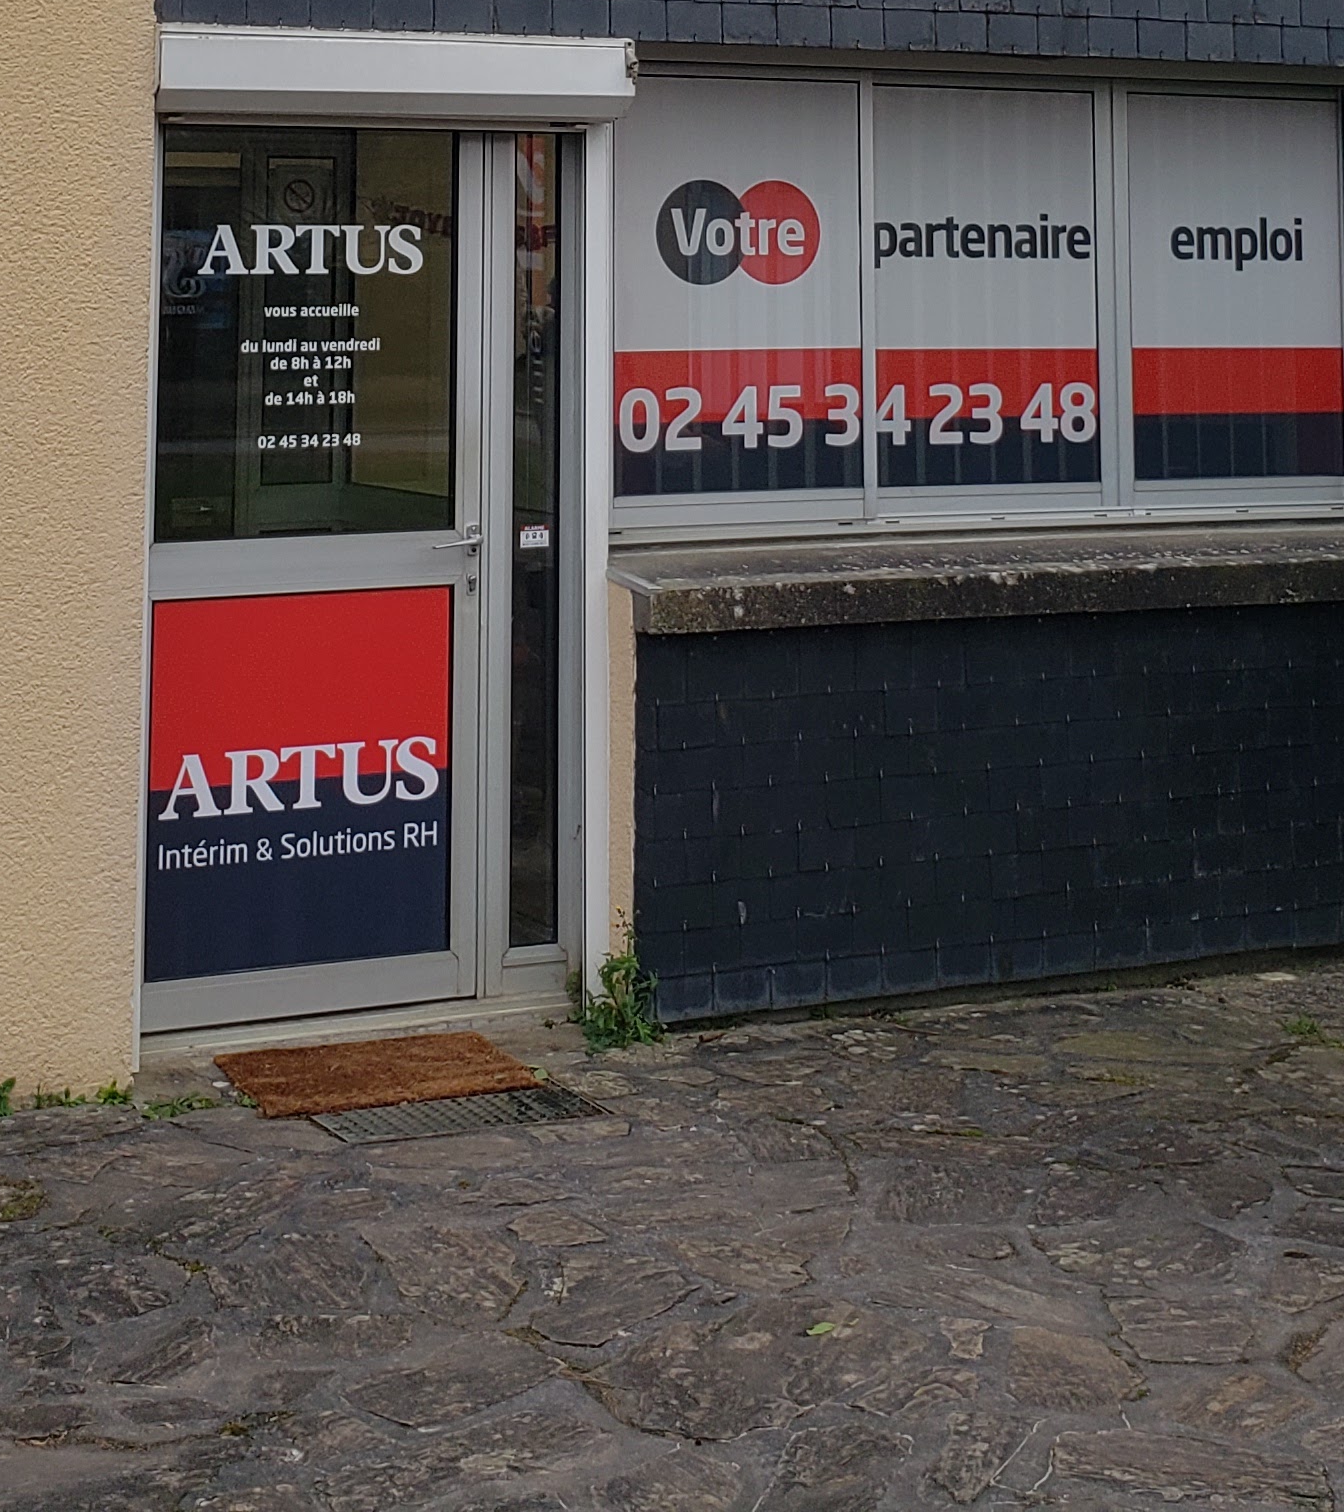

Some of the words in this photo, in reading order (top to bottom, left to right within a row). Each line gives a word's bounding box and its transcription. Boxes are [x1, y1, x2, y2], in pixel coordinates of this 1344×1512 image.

[670, 206, 806, 258] Votre
[874, 212, 1092, 270] partenaire
[1170, 216, 1304, 272] emploi
[197, 224, 423, 275] ARTUS
[264, 305, 296, 317] vous
[300, 303, 360, 317] accueille
[240, 339, 258, 353] du
[262, 338, 296, 353] lundi
[300, 340, 317, 352] au
[320, 337, 380, 352] vendredi
[269, 357, 287, 370] de
[291, 356, 308, 369] 8h
[312, 355, 321, 369] à
[324, 355, 351, 369] 12h
[303, 374, 318, 387] et
[264, 392, 282, 405] de
[285, 391, 313, 405] 14h
[316, 391, 324, 404] à
[328, 390, 355, 404] 18h
[618, 386, 703, 454] 02
[721, 384, 804, 449] 45
[824, 383, 912, 448] 34
[928, 382, 1004, 445] 23
[1020, 381, 1097, 445] 48
[257, 435, 275, 448] 02
[278, 434, 296, 448] 45
[300, 434, 318, 447] 34
[322, 433, 339, 447] 23
[343, 432, 361, 446] 48
[157, 735, 440, 821] ARTUS
[157, 838, 248, 871] Intérim
[256, 838, 274, 862] &
[280, 823, 396, 860] Solutions
[403, 820, 439, 849] RH
